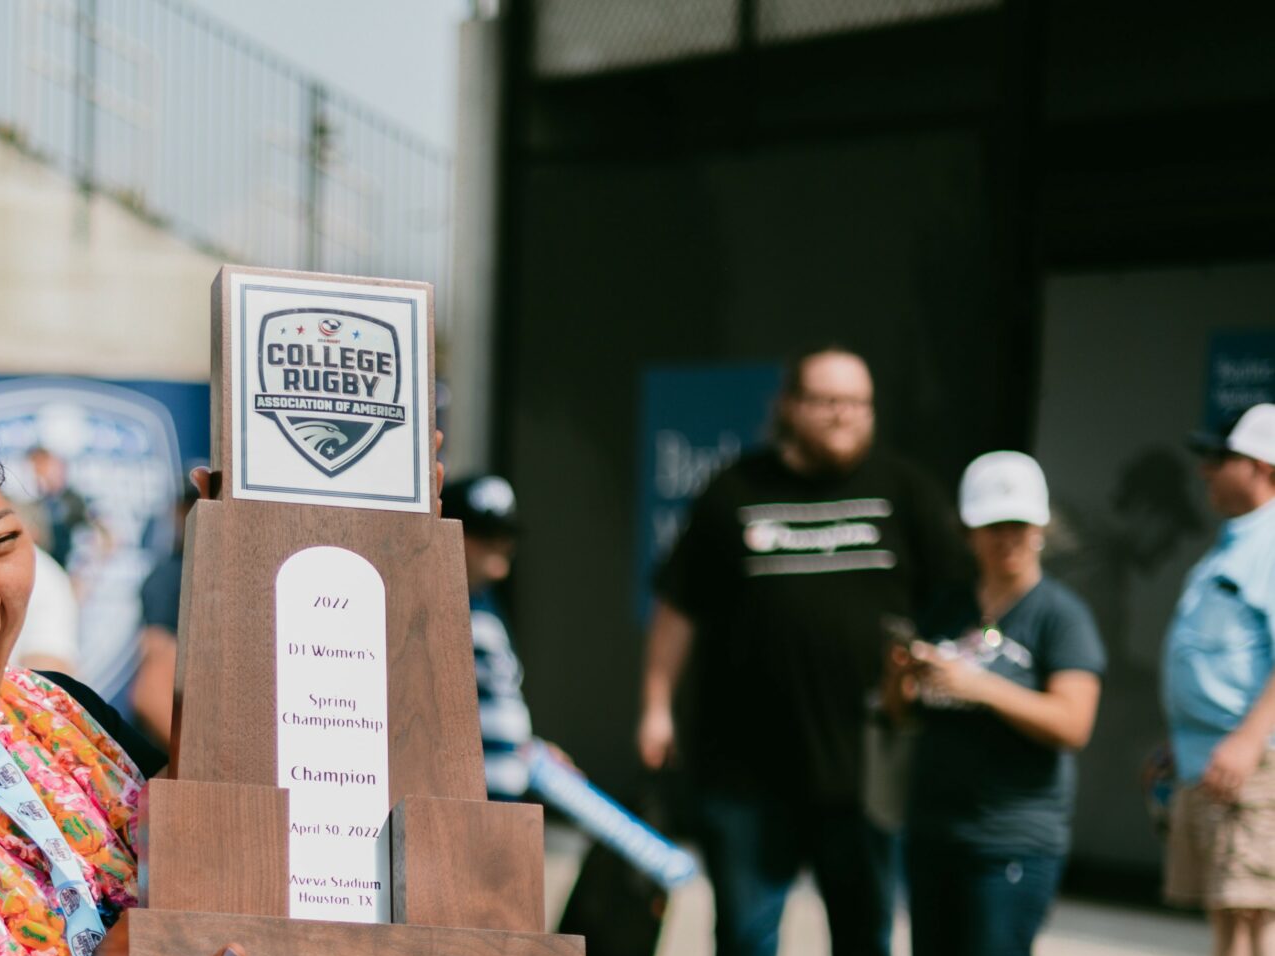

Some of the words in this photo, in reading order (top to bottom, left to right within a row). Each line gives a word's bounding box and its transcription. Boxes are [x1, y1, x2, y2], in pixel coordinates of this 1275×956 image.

[267, 343, 393, 376] COLLEGE
[283, 368, 380, 398] RUGBY
[257, 396, 332, 412] ASSOCIATION
[336, 401, 350, 412] OF
[353, 402, 404, 419] AMERICA
[313, 596, 349, 609] 2022
[312, 644, 375, 660] Women's
[309, 694, 356, 711] Spring
[282, 712, 383, 733] Championship
[291, 765, 376, 787] Champion
[290, 822, 320, 836] April
[348, 826, 379, 839] 2022
[289, 874, 327, 887] Aveva
[331, 877, 381, 890] Stadium
[359, 895, 373, 907] TX
